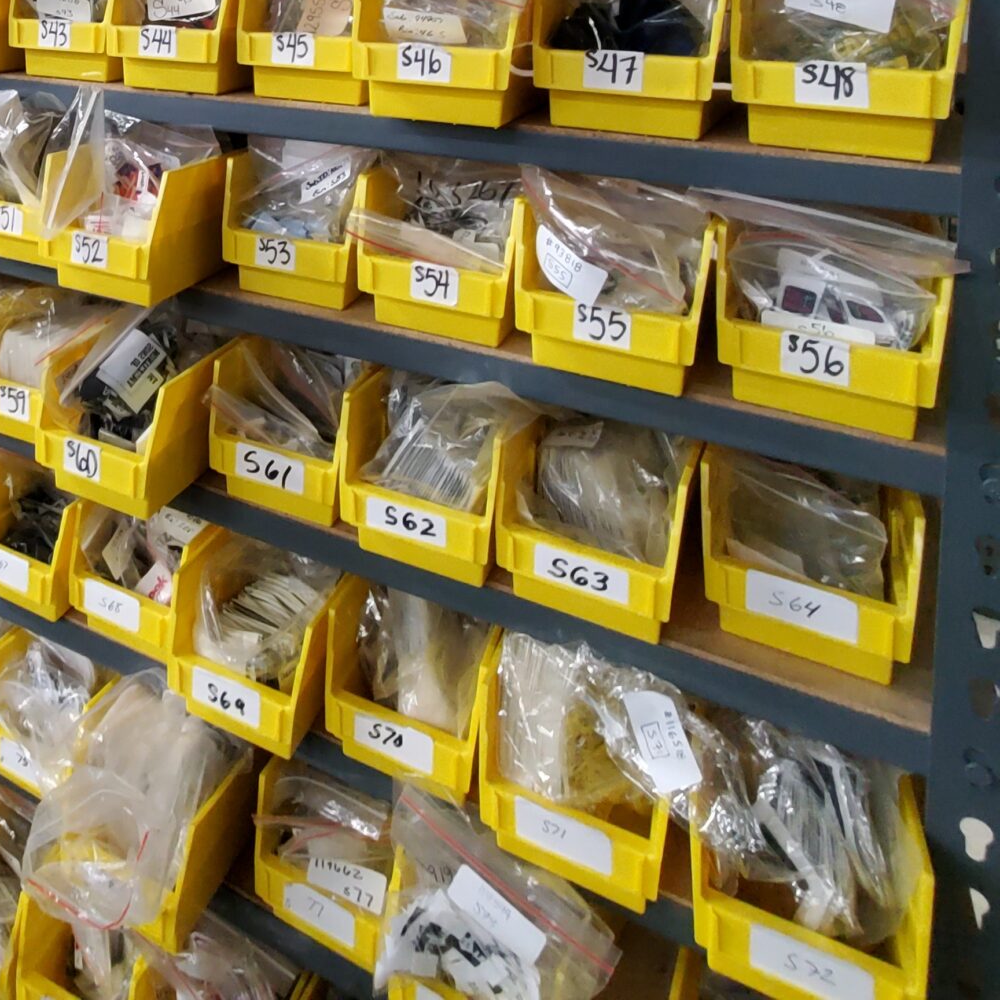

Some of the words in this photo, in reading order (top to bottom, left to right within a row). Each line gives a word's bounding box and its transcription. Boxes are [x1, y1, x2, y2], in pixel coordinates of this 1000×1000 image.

[41, 20, 67, 47] S43
[141, 28, 172, 53] S44
[277, 33, 308, 63] S45
[402, 47, 441, 74] S46
[585, 49, 638, 85] S47
[802, 65, 854, 100] S48
[75, 234, 103, 264] S52
[260, 240, 290, 264] S53
[415, 266, 449, 298] S54
[578, 304, 627, 343] S55
[789, 335, 844, 376] S56
[0, 386, 25, 414] S59
[68, 440, 98, 478] S60
[244, 451, 292, 488] S61
[386, 505, 437, 537] S62
[550, 559, 608, 591] S63
[770, 591, 821, 617] S64
[208, 683, 245, 716] S69
[368, 724, 403, 748] S70
